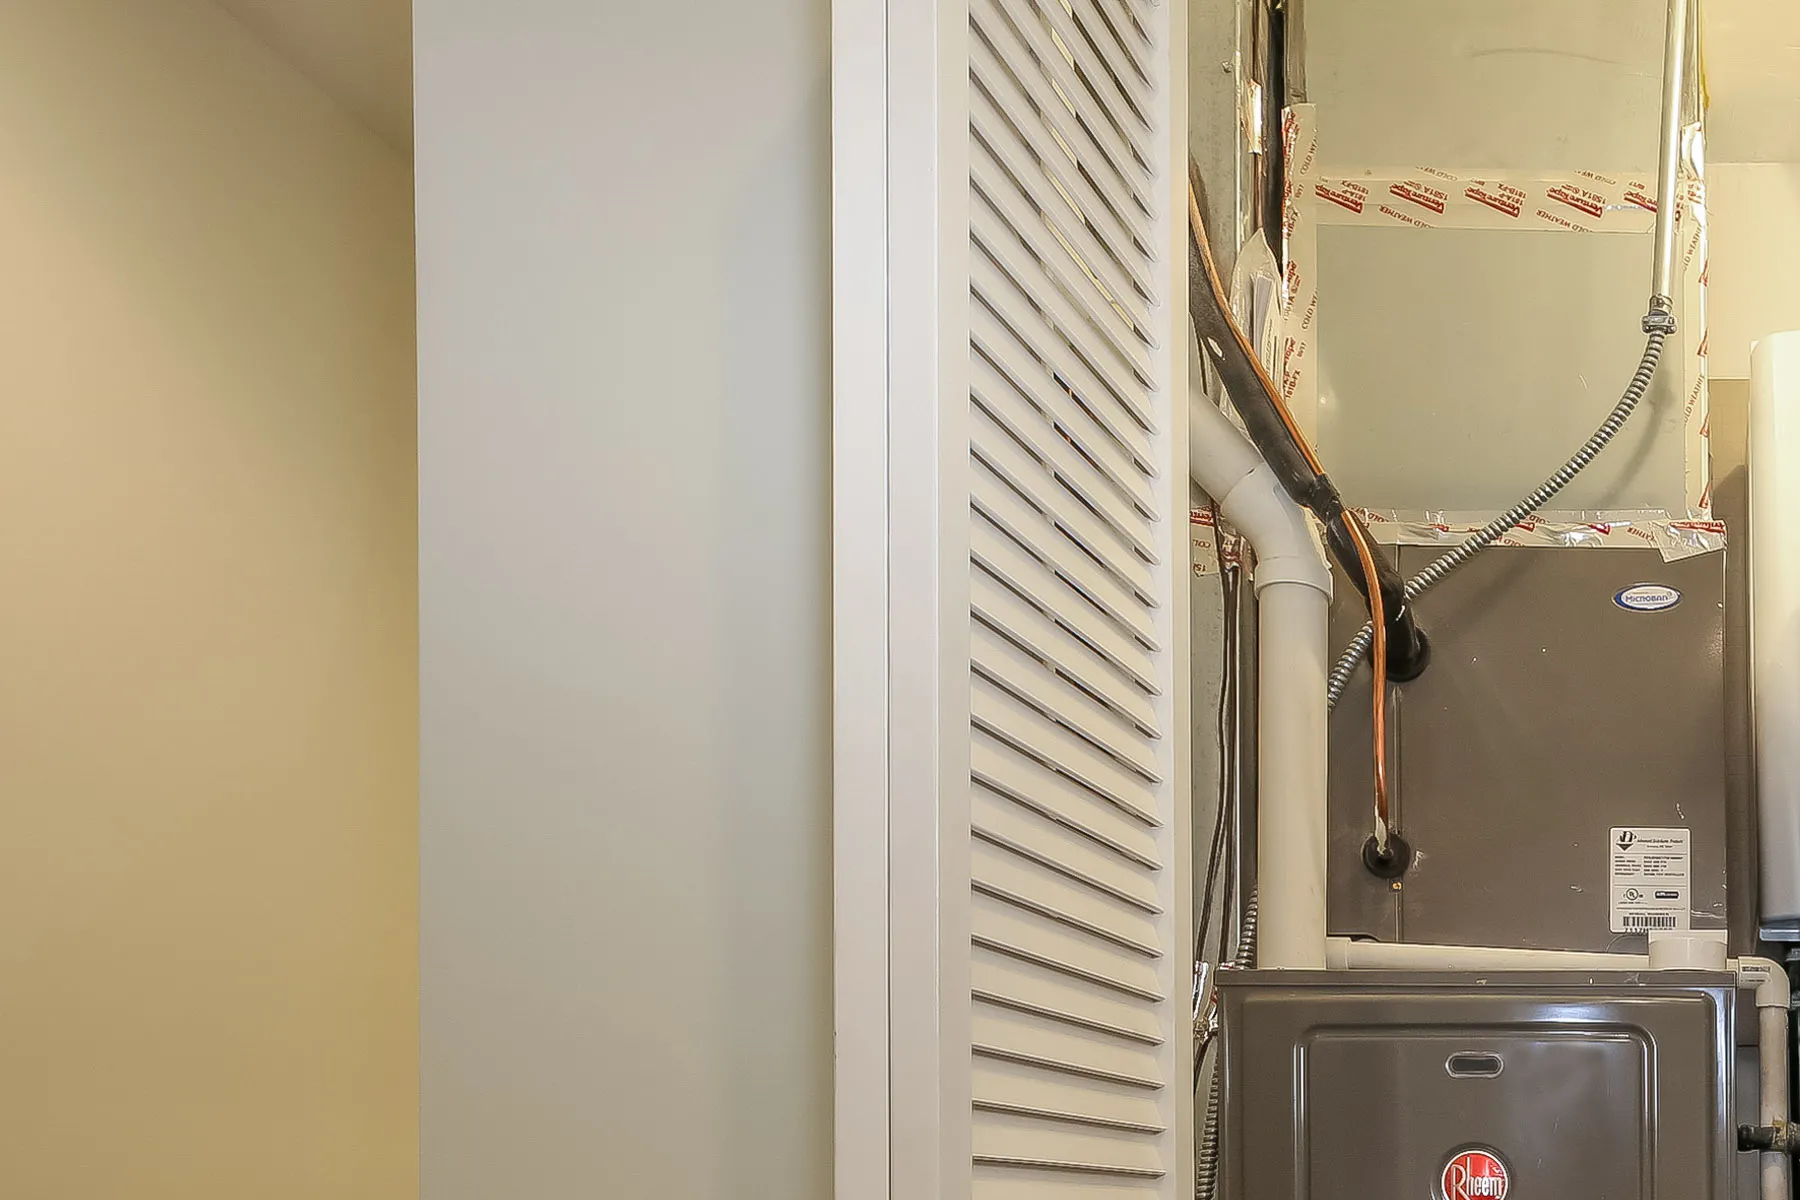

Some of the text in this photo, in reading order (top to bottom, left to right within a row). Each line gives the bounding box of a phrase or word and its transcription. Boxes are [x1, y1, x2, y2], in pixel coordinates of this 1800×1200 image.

[1546, 186, 1603, 213] Venture Tape
[1379, 204, 1413, 224] WEATHER
[1536, 209, 1571, 229] WEATHER
